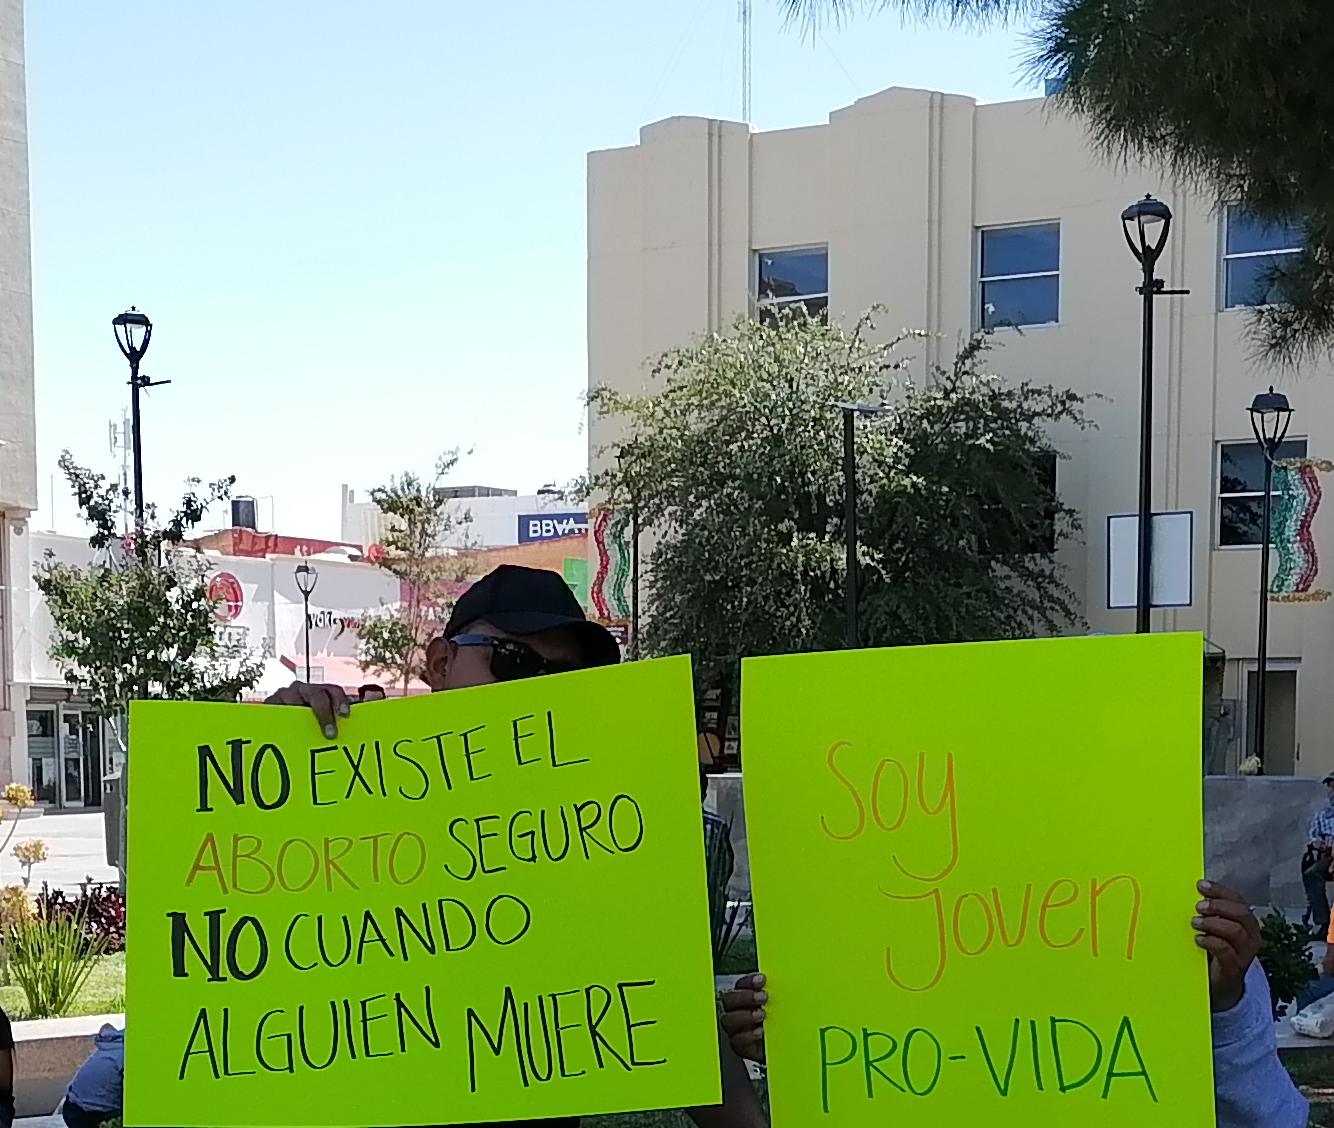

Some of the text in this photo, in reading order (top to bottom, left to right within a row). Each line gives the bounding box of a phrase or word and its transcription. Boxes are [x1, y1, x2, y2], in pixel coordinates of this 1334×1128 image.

[529, 517, 579, 537] BBVA
[196, 710, 590, 813] NO EXISTE EL
[821, 740, 959, 882] Soy
[185, 793, 644, 896] ABORTO SEGURO
[166, 894, 531, 982] NO CUANDO
[178, 979, 668, 1093] ALGUIEN MUERE
[819, 1015, 1159, 1113] PRO-VIDA
